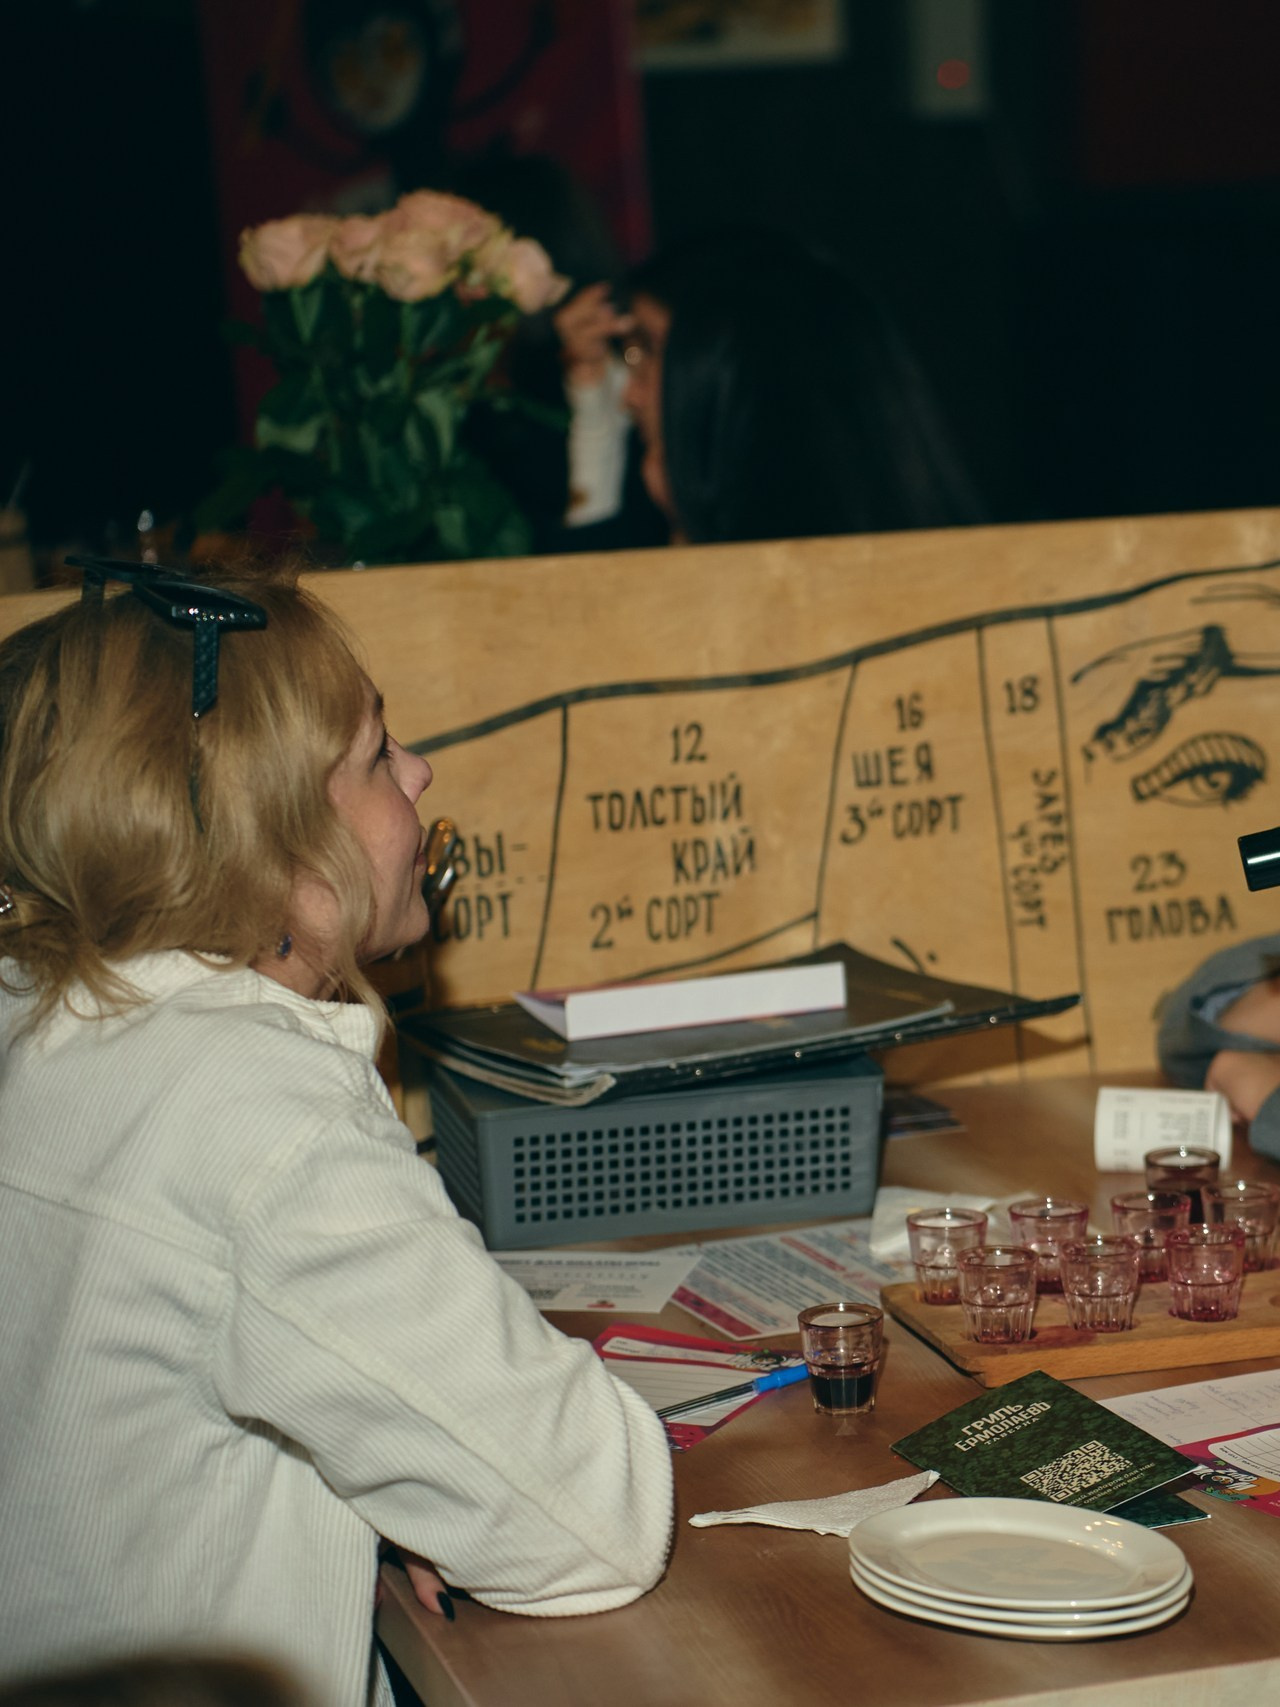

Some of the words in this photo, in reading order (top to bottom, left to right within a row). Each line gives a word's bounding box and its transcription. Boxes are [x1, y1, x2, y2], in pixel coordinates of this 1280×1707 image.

[895, 691, 925, 731] 16
[1005, 676, 1039, 714] 18
[671, 720, 707, 764] 12
[851, 742, 934, 789] ШЕЯ
[586, 773, 744, 833] ТОЛСТЫЙ
[893, 794, 965, 839] СОРТ
[1032, 768, 1067, 876] ЗАРЕЗ
[671, 827, 758, 886] КРАЙ
[1131, 851, 1188, 893] 23
[645, 891, 720, 942] СОРТ
[1012, 864, 1048, 932] СОРТ
[1105, 893, 1239, 944] ГОЛОВА
[954, 1401, 1051, 1452] ЕРМОЛАЕВЪ
[961, 1404, 1024, 1436] ГРИЛЬ
[984, 1417, 1040, 1446] ТАВЕРНА
